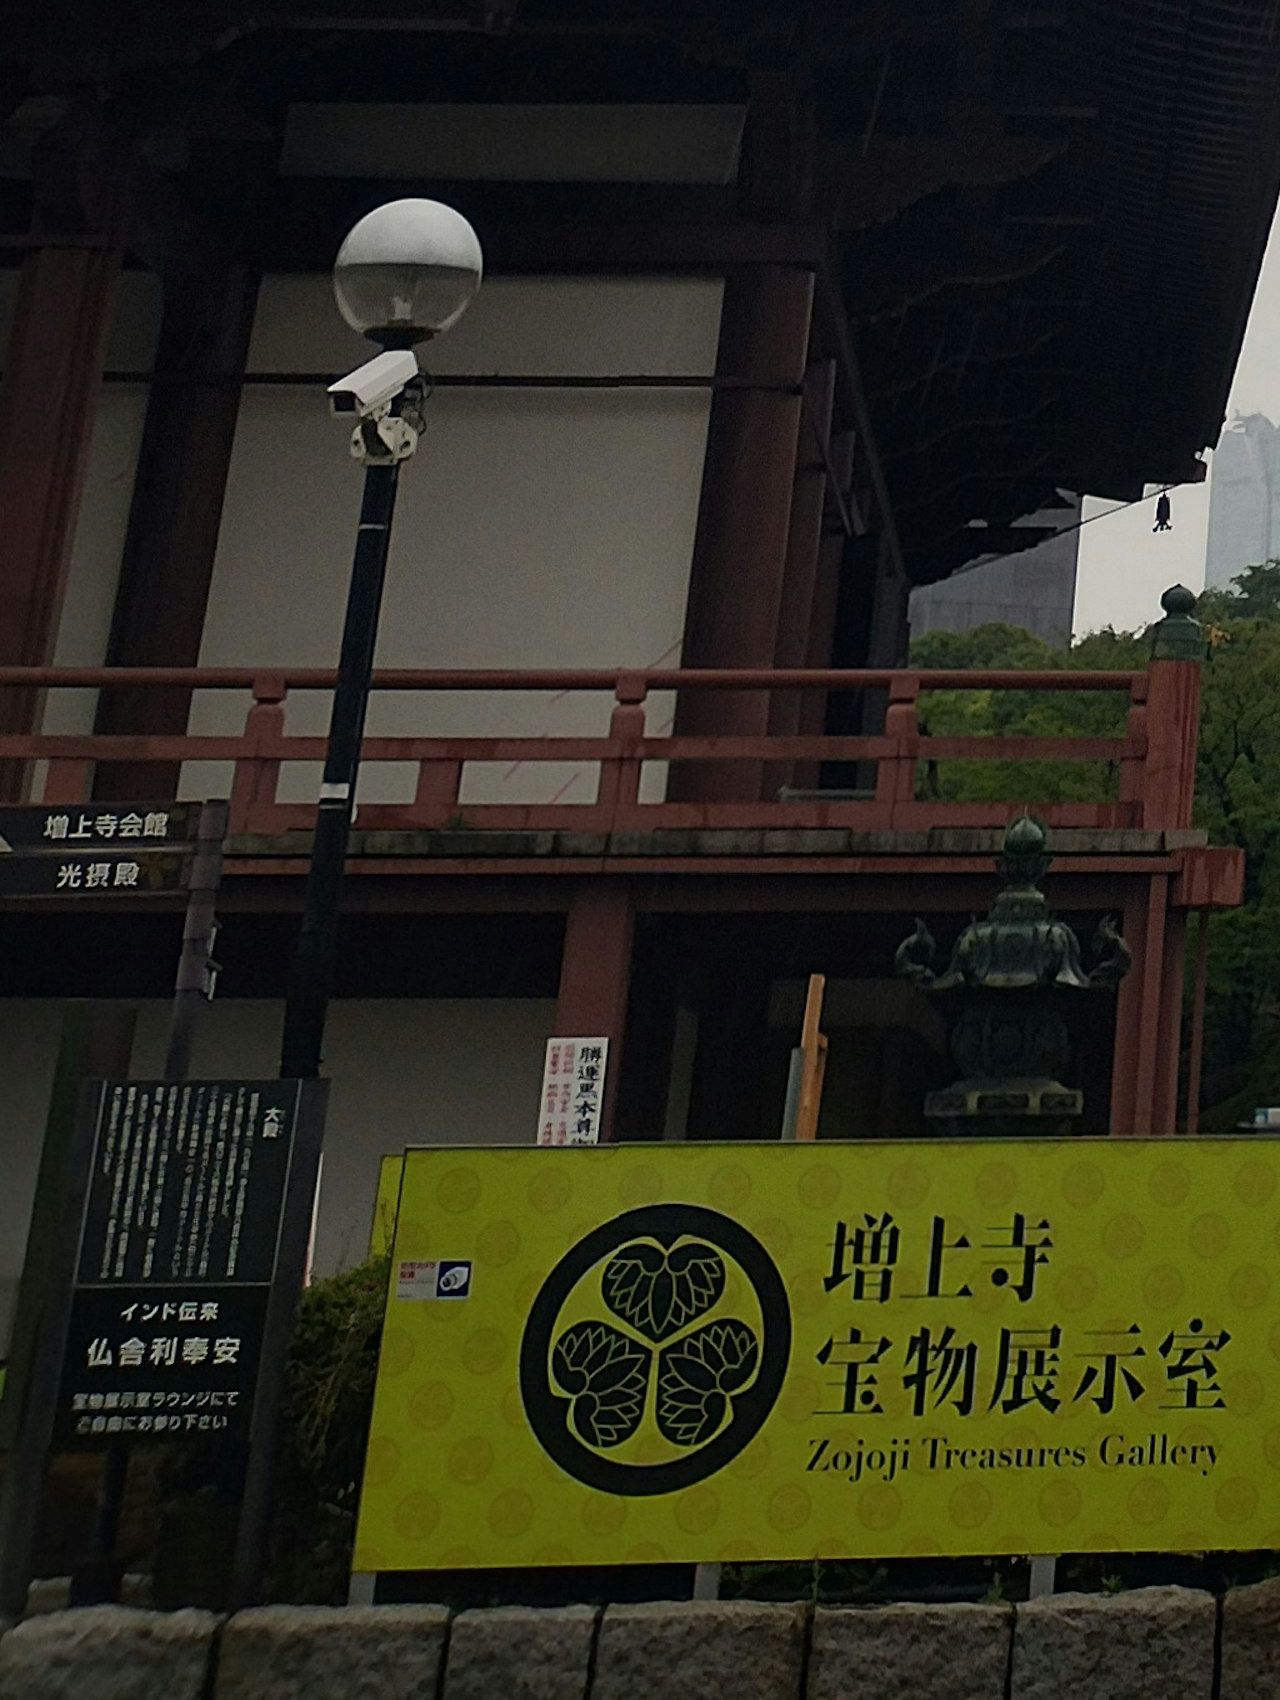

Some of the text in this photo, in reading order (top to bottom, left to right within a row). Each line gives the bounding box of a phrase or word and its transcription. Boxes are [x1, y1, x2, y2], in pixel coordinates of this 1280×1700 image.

[43, 811, 170, 840] 増上寺会館
[55, 861, 141, 889] 光摂殿
[822, 1211, 1054, 1304] 増上寺
[119, 1300, 220, 1324] インド伝来
[86, 1336, 242, 1368] 仏舎利奉安
[811, 1318, 1232, 1417] 宝物展示室
[806, 1433, 1221, 1483] Zojoji Treasures Gallery
